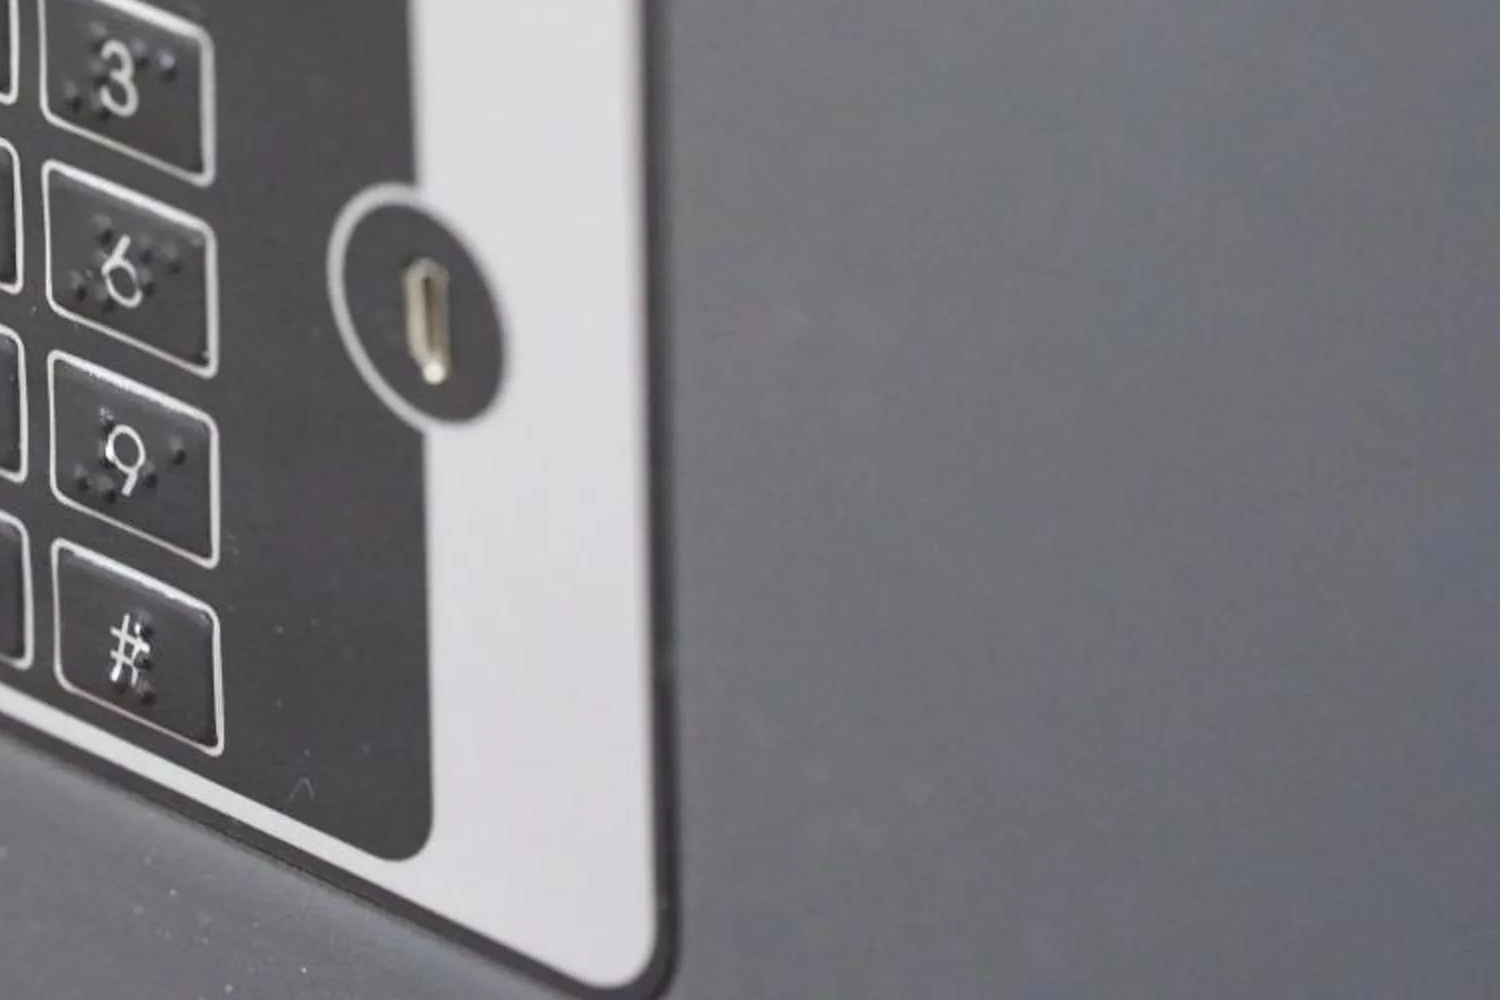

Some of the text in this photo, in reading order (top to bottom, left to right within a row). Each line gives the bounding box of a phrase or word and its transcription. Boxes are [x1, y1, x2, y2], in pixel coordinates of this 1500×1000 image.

[100, 39, 139, 117] 3
[102, 235, 143, 308] 6
[105, 424, 146, 497] 9
[109, 613, 150, 686] #
